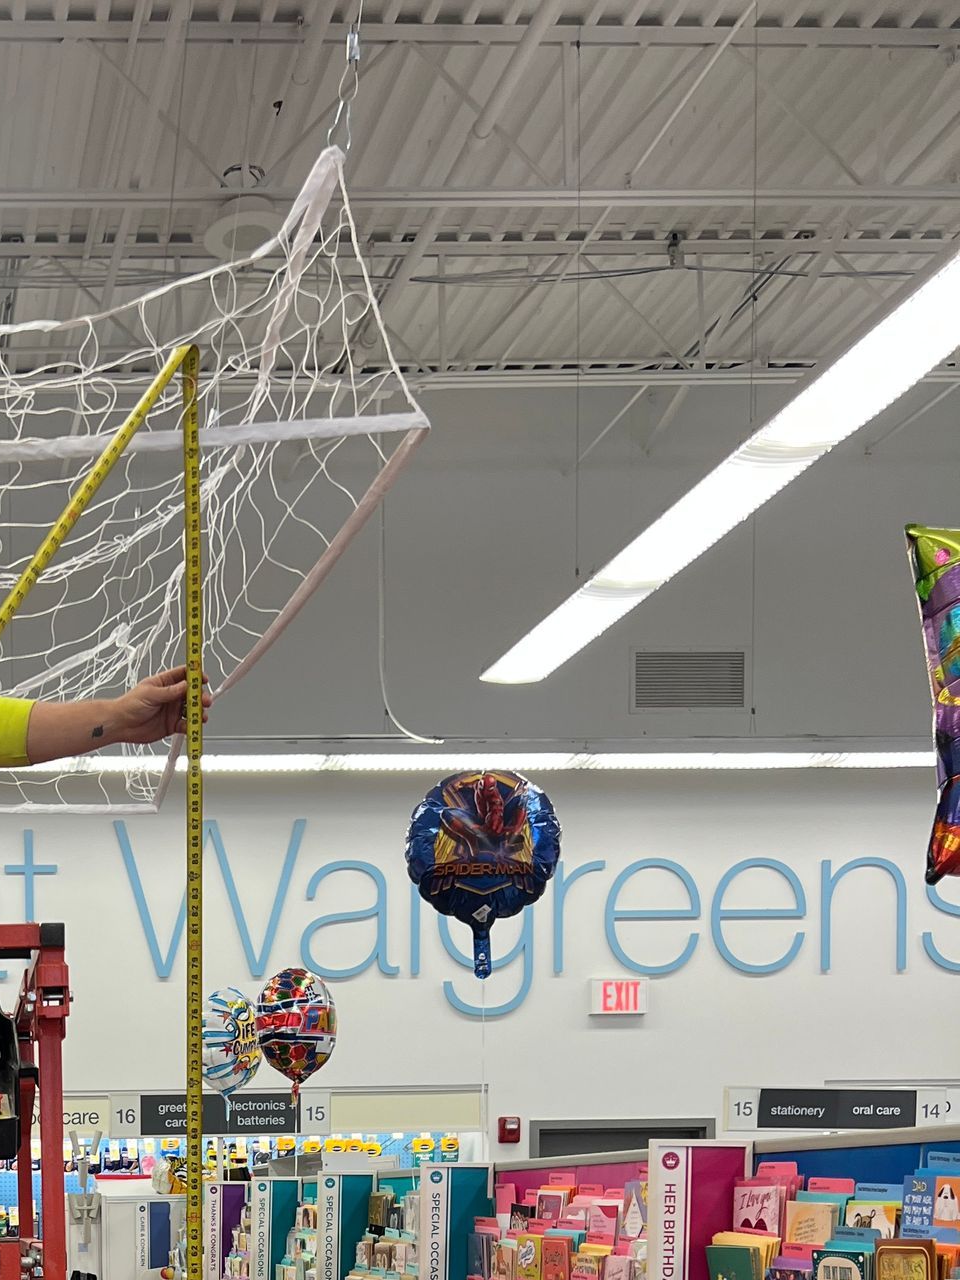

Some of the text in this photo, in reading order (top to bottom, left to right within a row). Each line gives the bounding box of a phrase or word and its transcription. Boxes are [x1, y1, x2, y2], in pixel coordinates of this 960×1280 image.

[192, 678, 198, 690] 95
[192, 749, 198, 761] 91
[192, 836, 198, 848] 86
[433, 862, 534, 877] SPIDER-MAN
[192, 906, 198, 918] 82
[192, 992, 198, 1004] 77
[602, 981, 640, 1011] EXIT
[191, 1095, 198, 1106] 71
[158, 1102, 188, 1116] greet
[305, 1105, 325, 1121] 15
[734, 1101, 753, 1117] 15
[770, 1105, 825, 1118] stationery
[852, 1104, 901, 1116] oral care
[922, 1103, 941, 1119] 14
[116, 1108, 136, 1124] 16
[165, 1117, 188, 1127] car
[237, 1114, 285, 1126] batteries
[192, 1162, 197, 1174] 67
[664, 1183, 677, 1215] HER
[326, 1195, 334, 1233] SPECIAL
[432, 1192, 441, 1239] SPECIAL
[191, 1229, 197, 1241] 63
[257, 1197, 266, 1277] SPECIAL OCCASIONS
